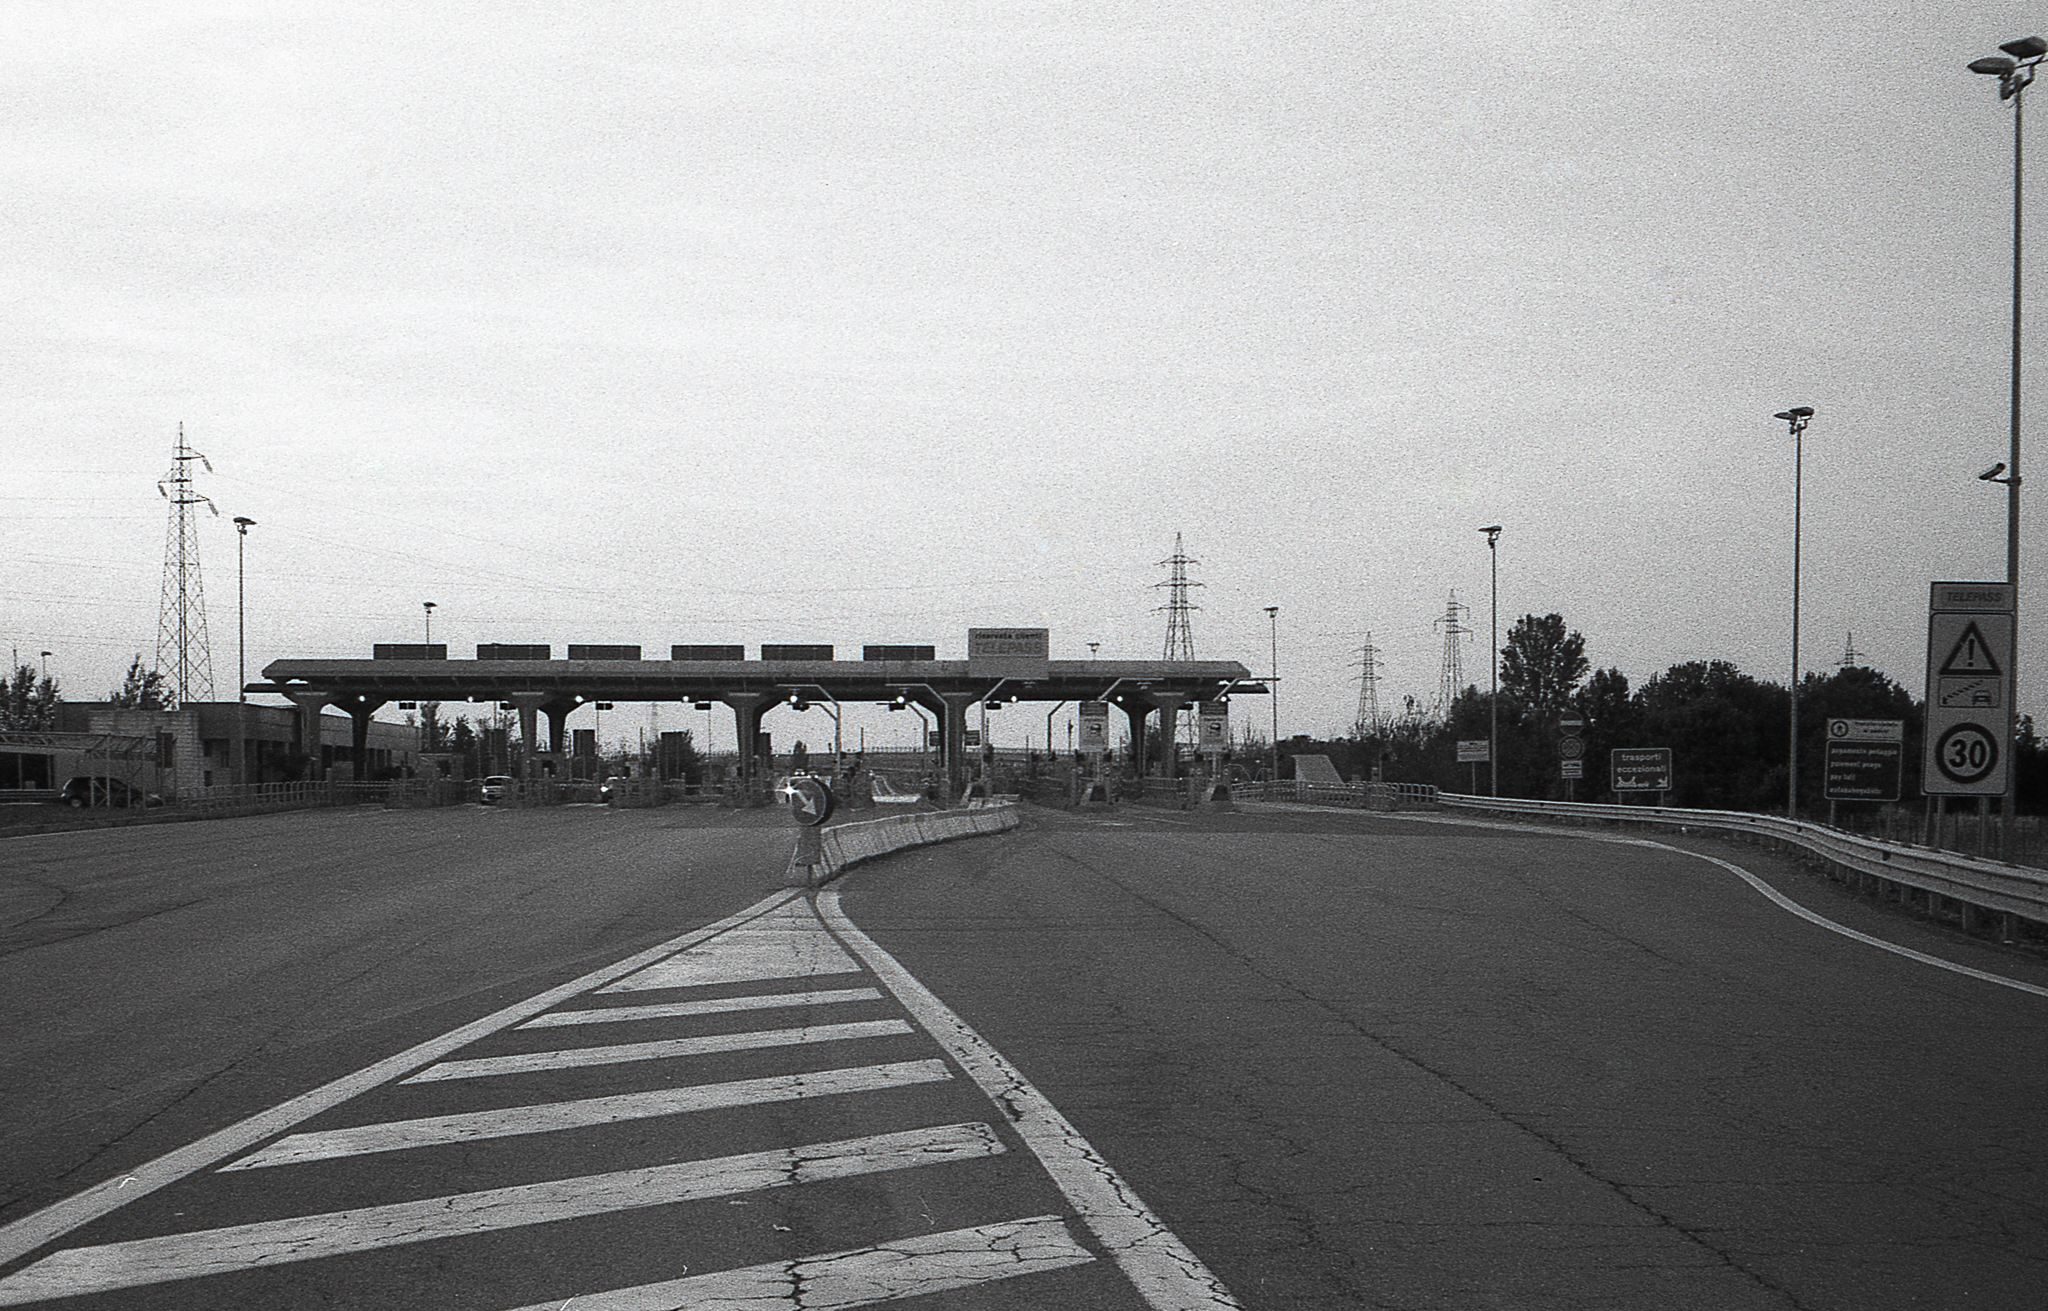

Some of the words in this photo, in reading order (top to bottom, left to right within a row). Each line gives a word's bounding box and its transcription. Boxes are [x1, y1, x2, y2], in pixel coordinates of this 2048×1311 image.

[1947, 592, 2003, 601] TELEPASS
[975, 641, 1043, 654] TELEPASS
[1622, 753, 1662, 762] trasporti
[1949, 739, 1987, 768] 30
[1616, 764, 1667, 773] eccezionali
